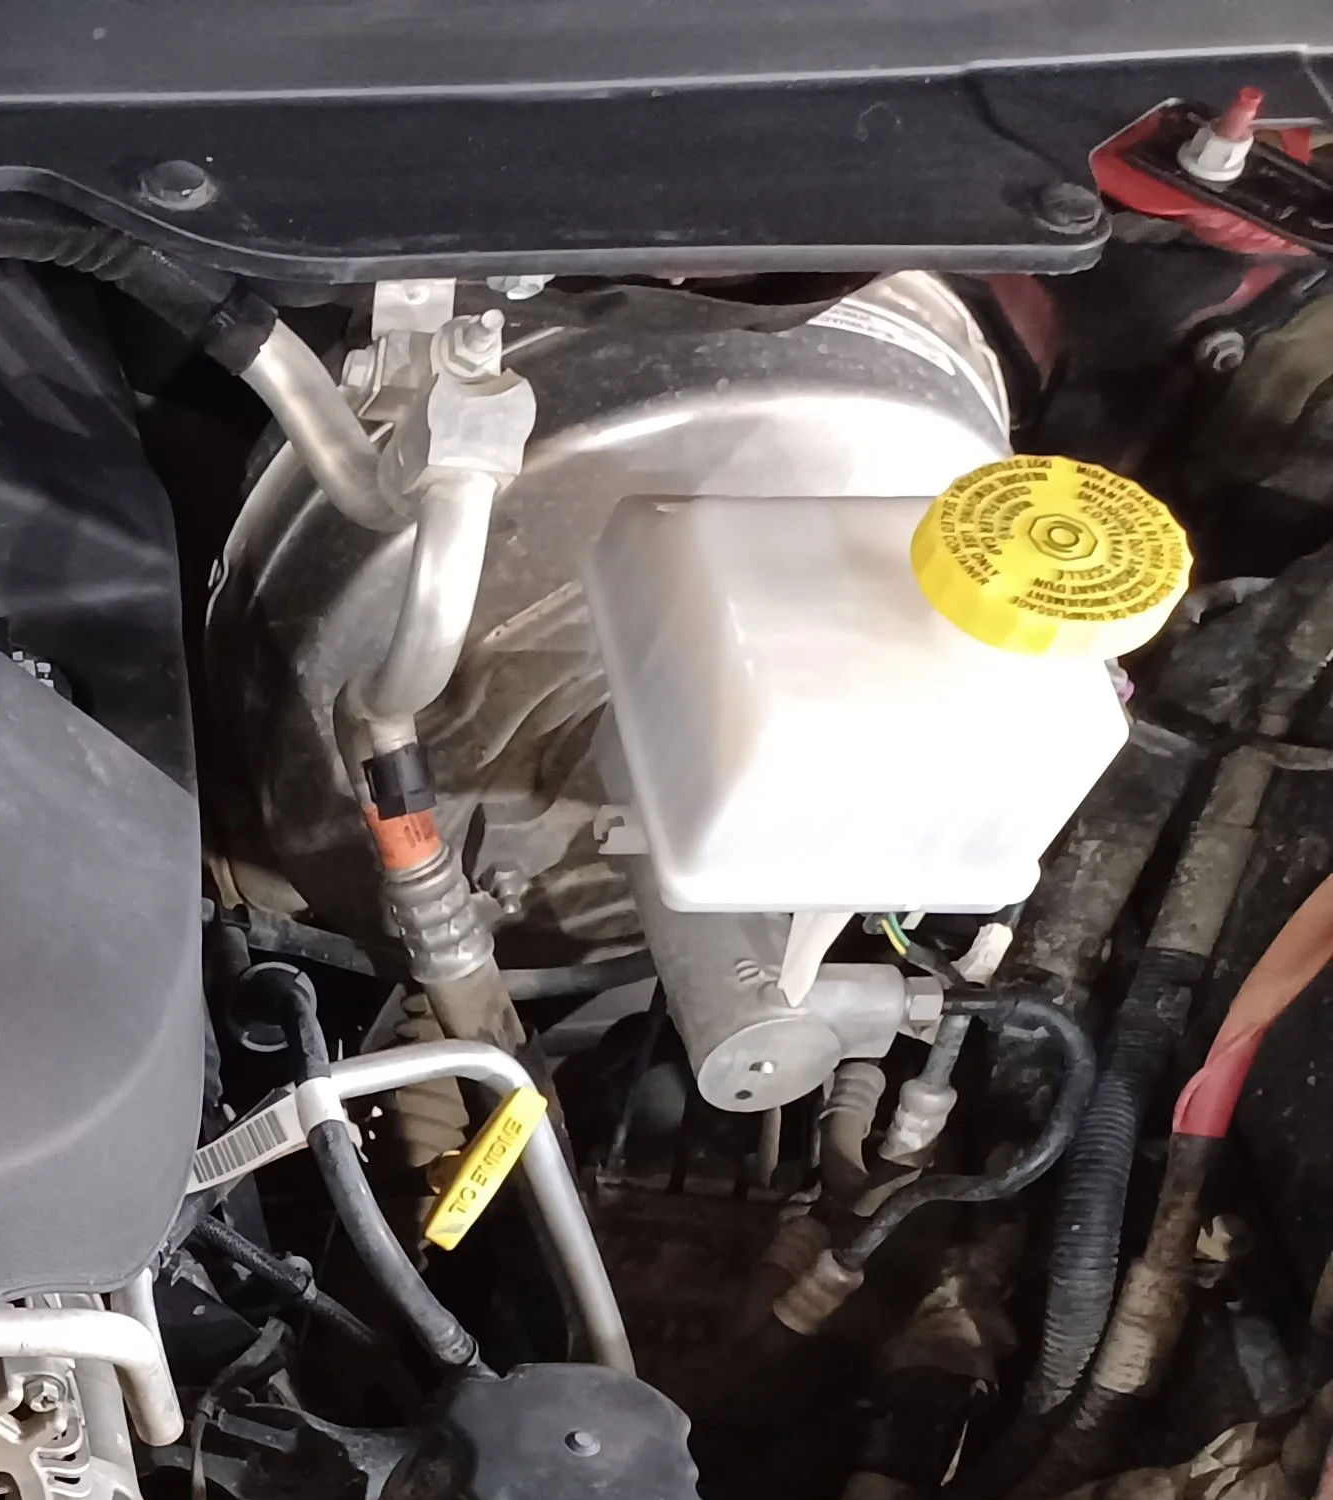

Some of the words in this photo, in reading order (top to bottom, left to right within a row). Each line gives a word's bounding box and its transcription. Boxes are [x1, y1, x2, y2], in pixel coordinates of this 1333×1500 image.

[1081, 476, 1127, 501] AVANT
[982, 536, 1005, 556] CAP
[971, 551, 1004, 577] ONLY
